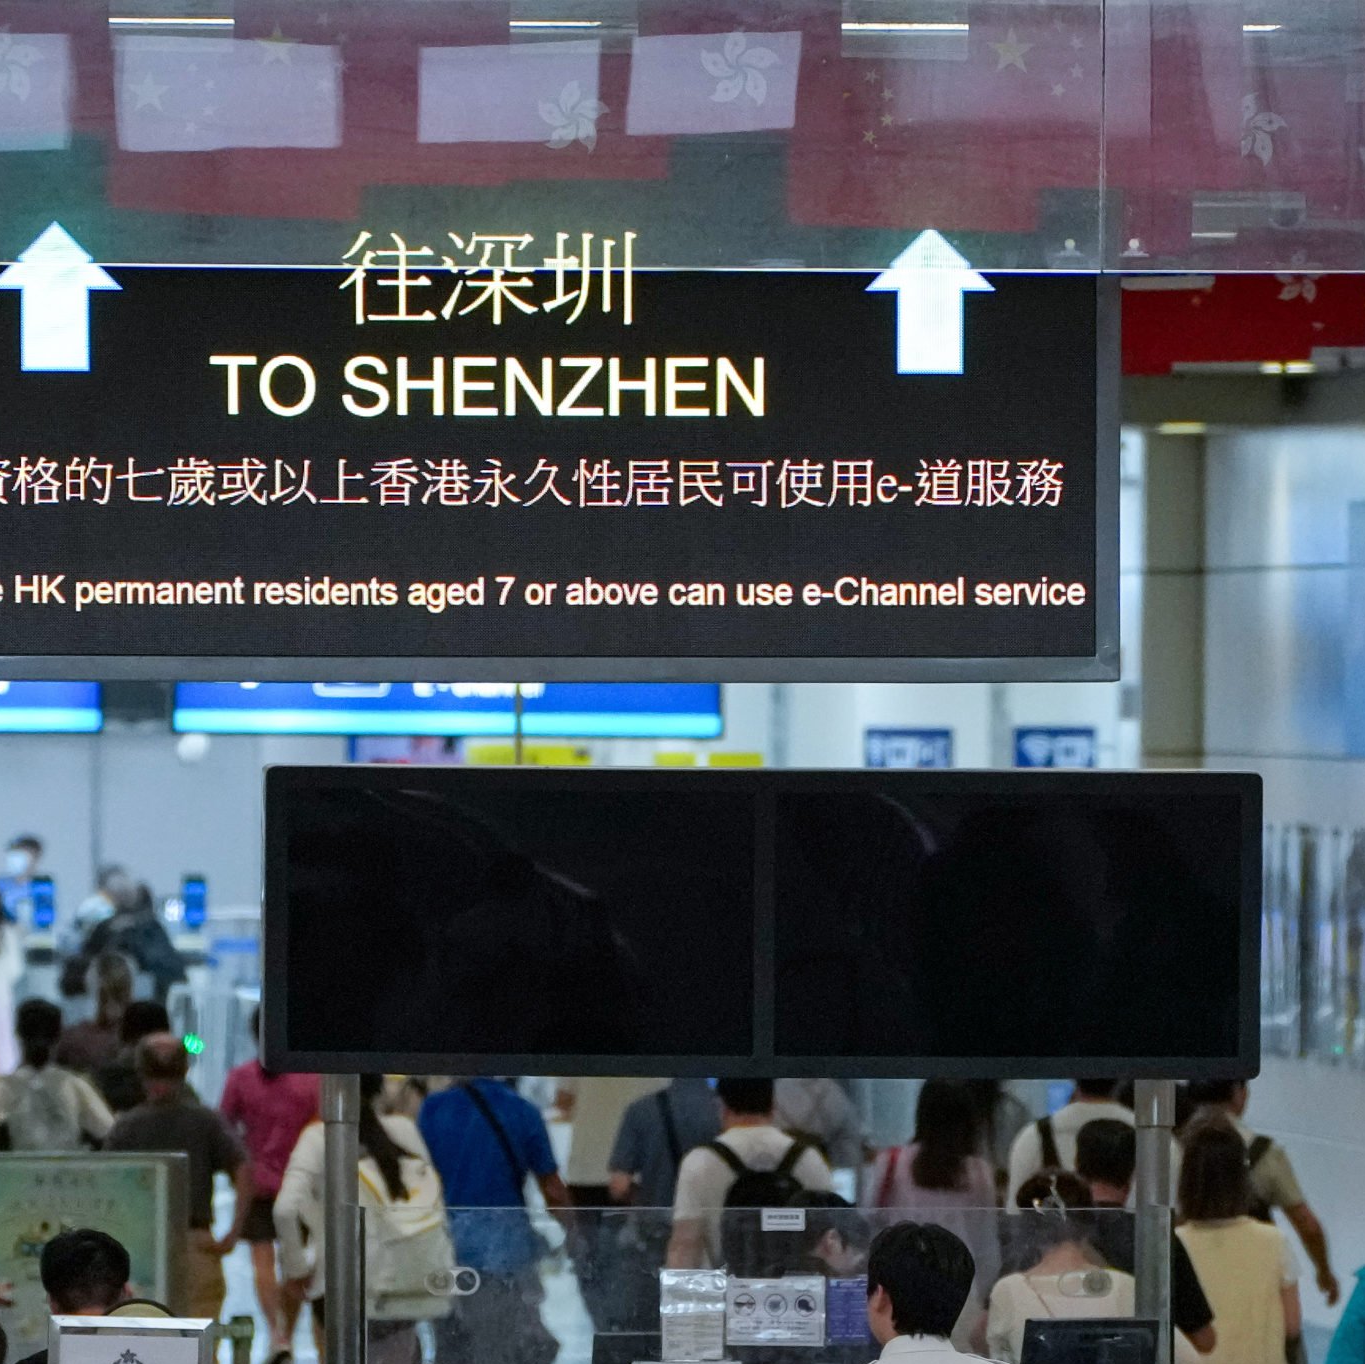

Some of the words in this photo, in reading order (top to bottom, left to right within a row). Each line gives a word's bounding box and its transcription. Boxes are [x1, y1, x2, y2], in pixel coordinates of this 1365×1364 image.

[338, 230, 637, 326] 往深圳
[209, 354, 317, 418] TO
[342, 354, 766, 419] SHENZHEN
[14, 575, 66, 605] HK
[75, 576, 245, 612] permanent
[253, 576, 399, 606] residents
[408, 576, 485, 613] aged
[496, 577, 517, 606] 7
[524, 583, 557, 607] or
[566, 577, 659, 607] above
[668, 583, 726, 607] can
[736, 584, 793, 607] use
[802, 576, 966, 607] e-Channel
[975, 576, 1088, 607] service
